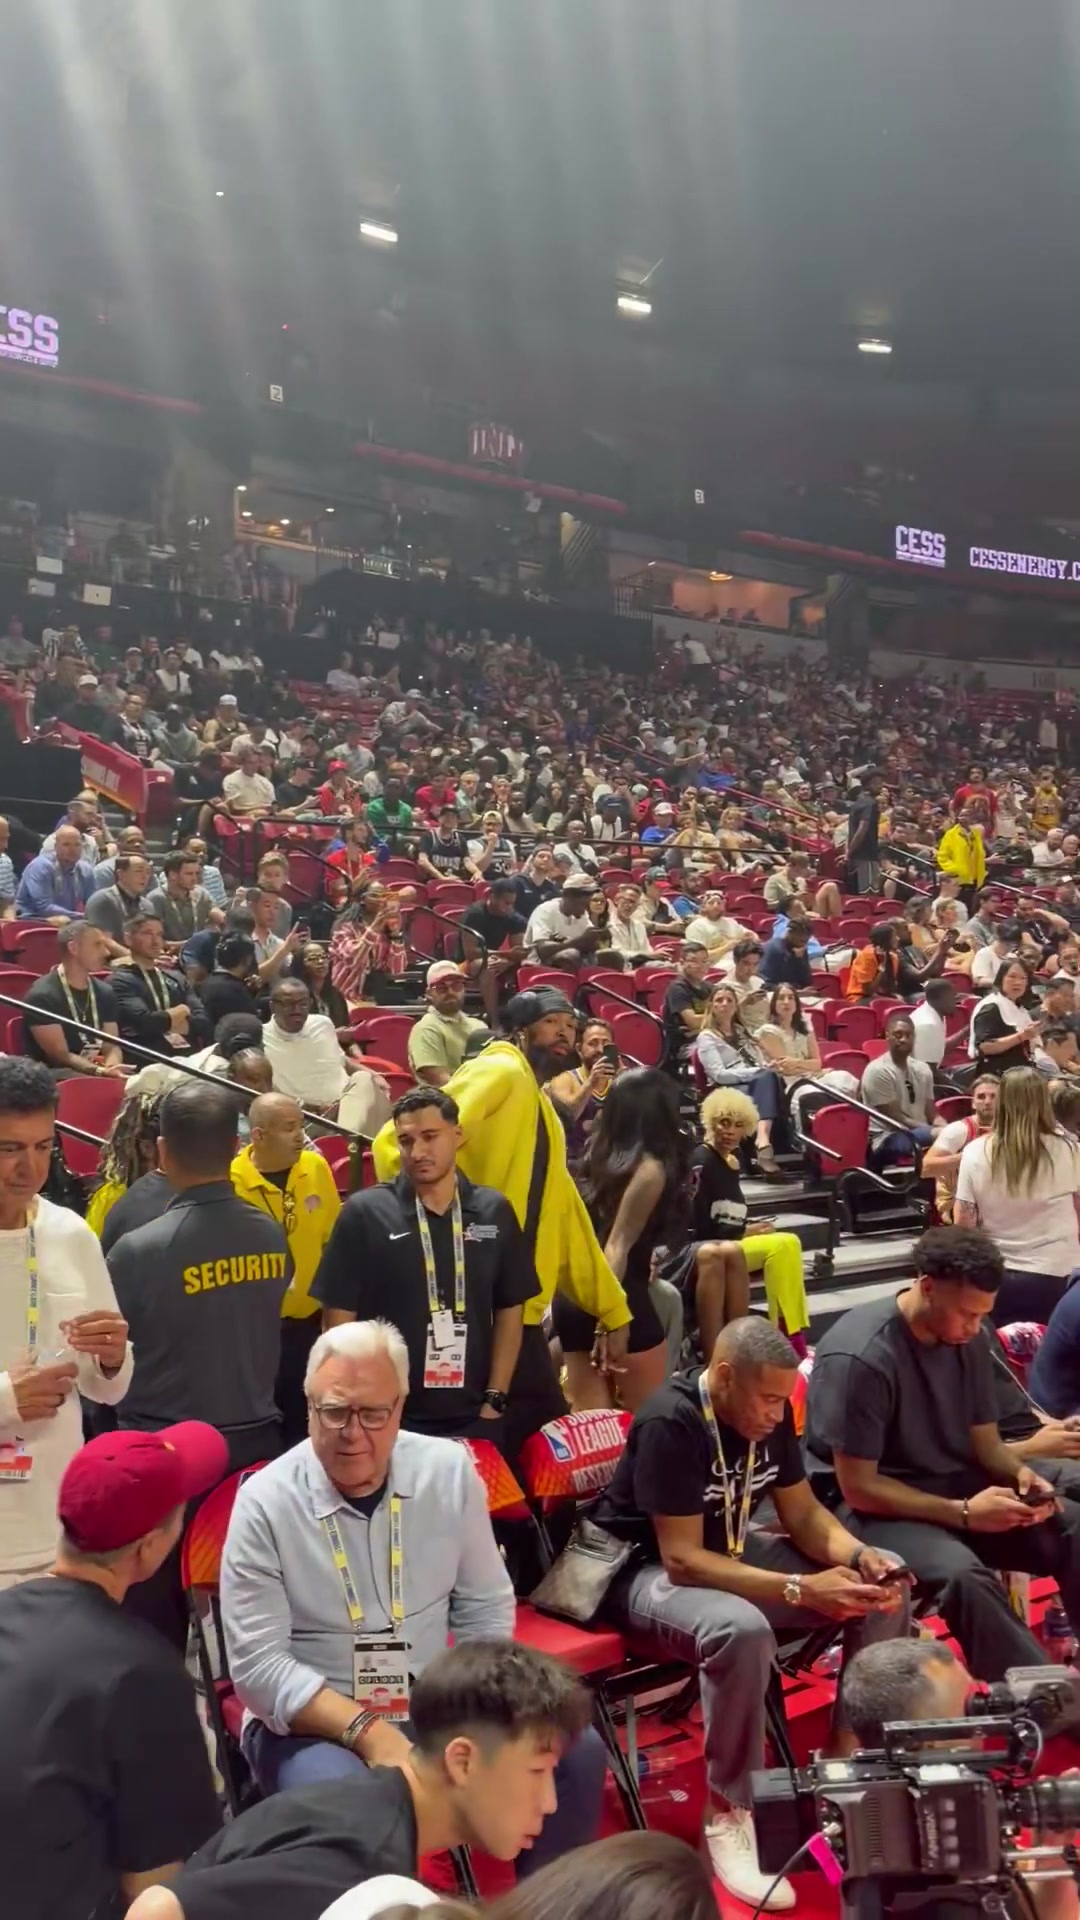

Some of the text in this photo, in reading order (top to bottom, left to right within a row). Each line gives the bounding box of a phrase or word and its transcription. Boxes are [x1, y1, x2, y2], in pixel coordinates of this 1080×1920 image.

[896, 525, 946, 559] CESS
[183, 1252, 286, 1295] SECURITY
[574, 1417, 627, 1455] LEAGUE
